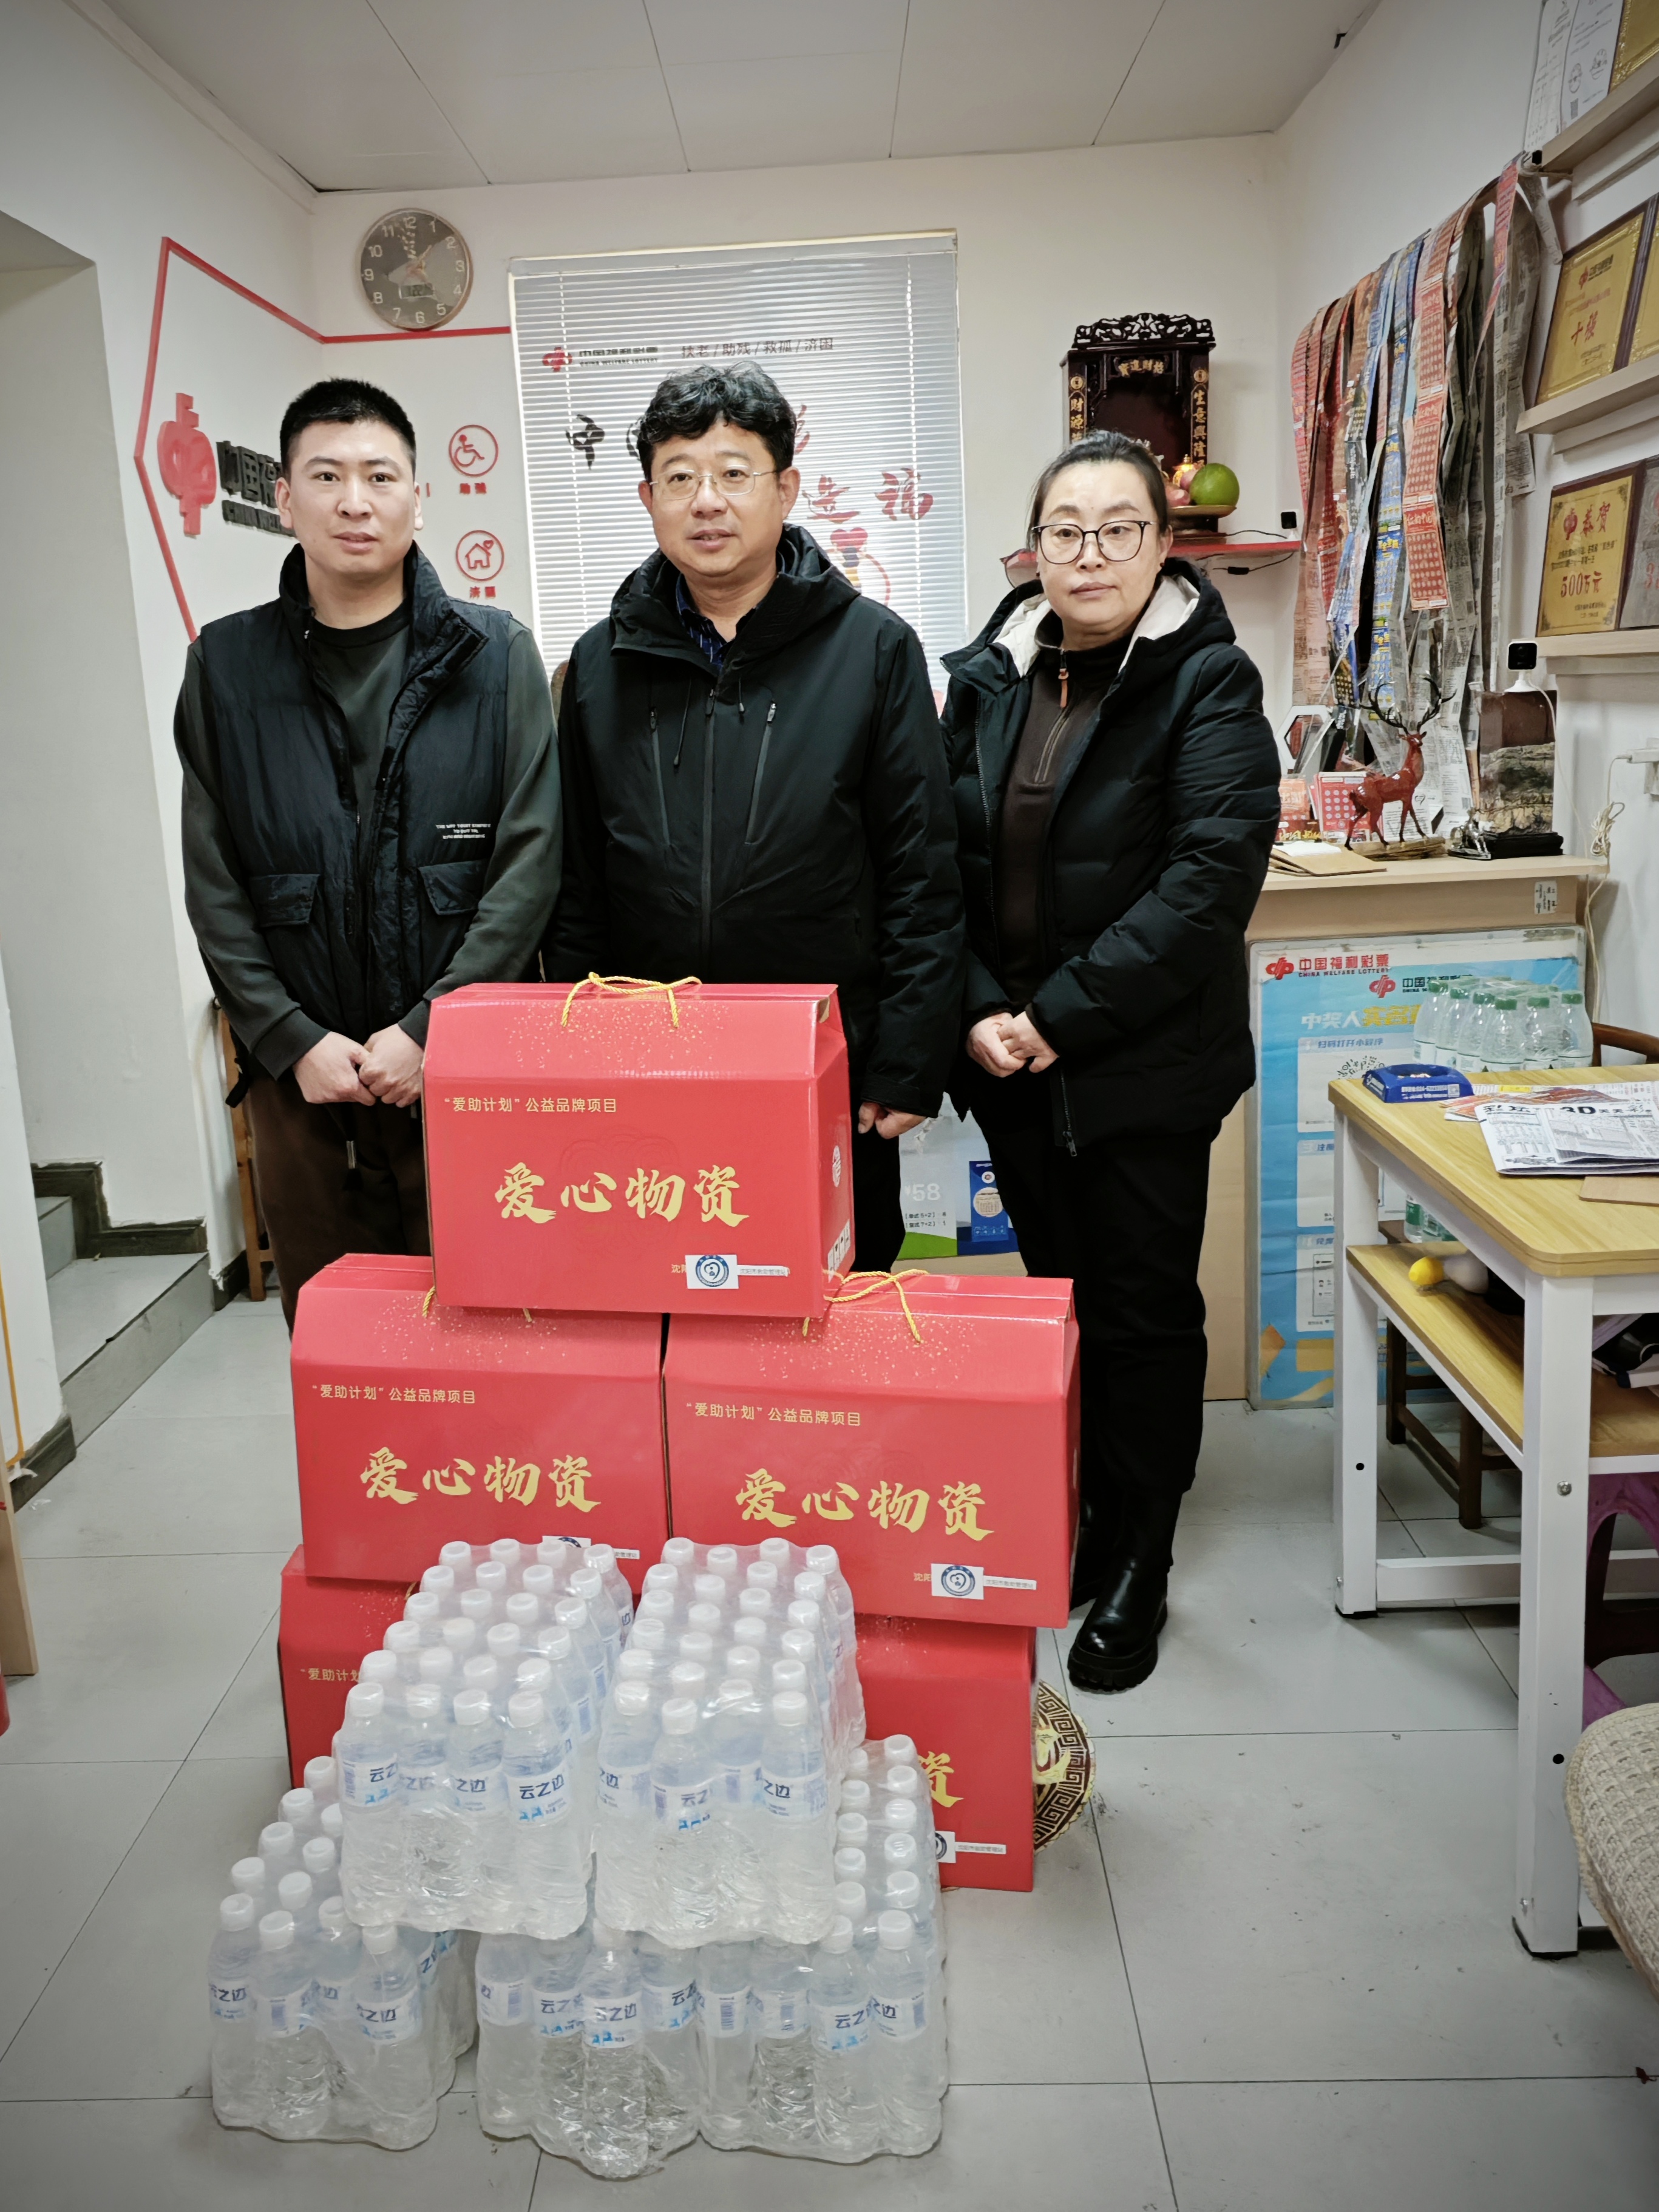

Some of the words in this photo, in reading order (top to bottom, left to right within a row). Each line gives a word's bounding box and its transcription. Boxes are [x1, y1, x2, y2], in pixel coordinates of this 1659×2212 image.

[403, 216, 417, 229] 12
[429, 220, 436, 233] 1
[382, 225, 395, 237] 11
[445, 236, 456, 249] 2
[368, 245, 383, 257] 10
[455, 260, 465, 273] 3
[364, 268, 374, 282] 9
[453, 284, 462, 294] 4
[373, 292, 384, 304] 8
[393, 307, 401, 320] 7
[436, 303, 446, 316] 5
[415, 311, 425, 324] 6
[1299, 954, 1389, 971] 中国福利彩票
[495, 1162, 750, 1227] 爱心物资
[360, 1447, 602, 1513] 爱心物资
[735, 1468, 995, 1541] 爱心物资
[519, 1773, 565, 1800] 云之边
